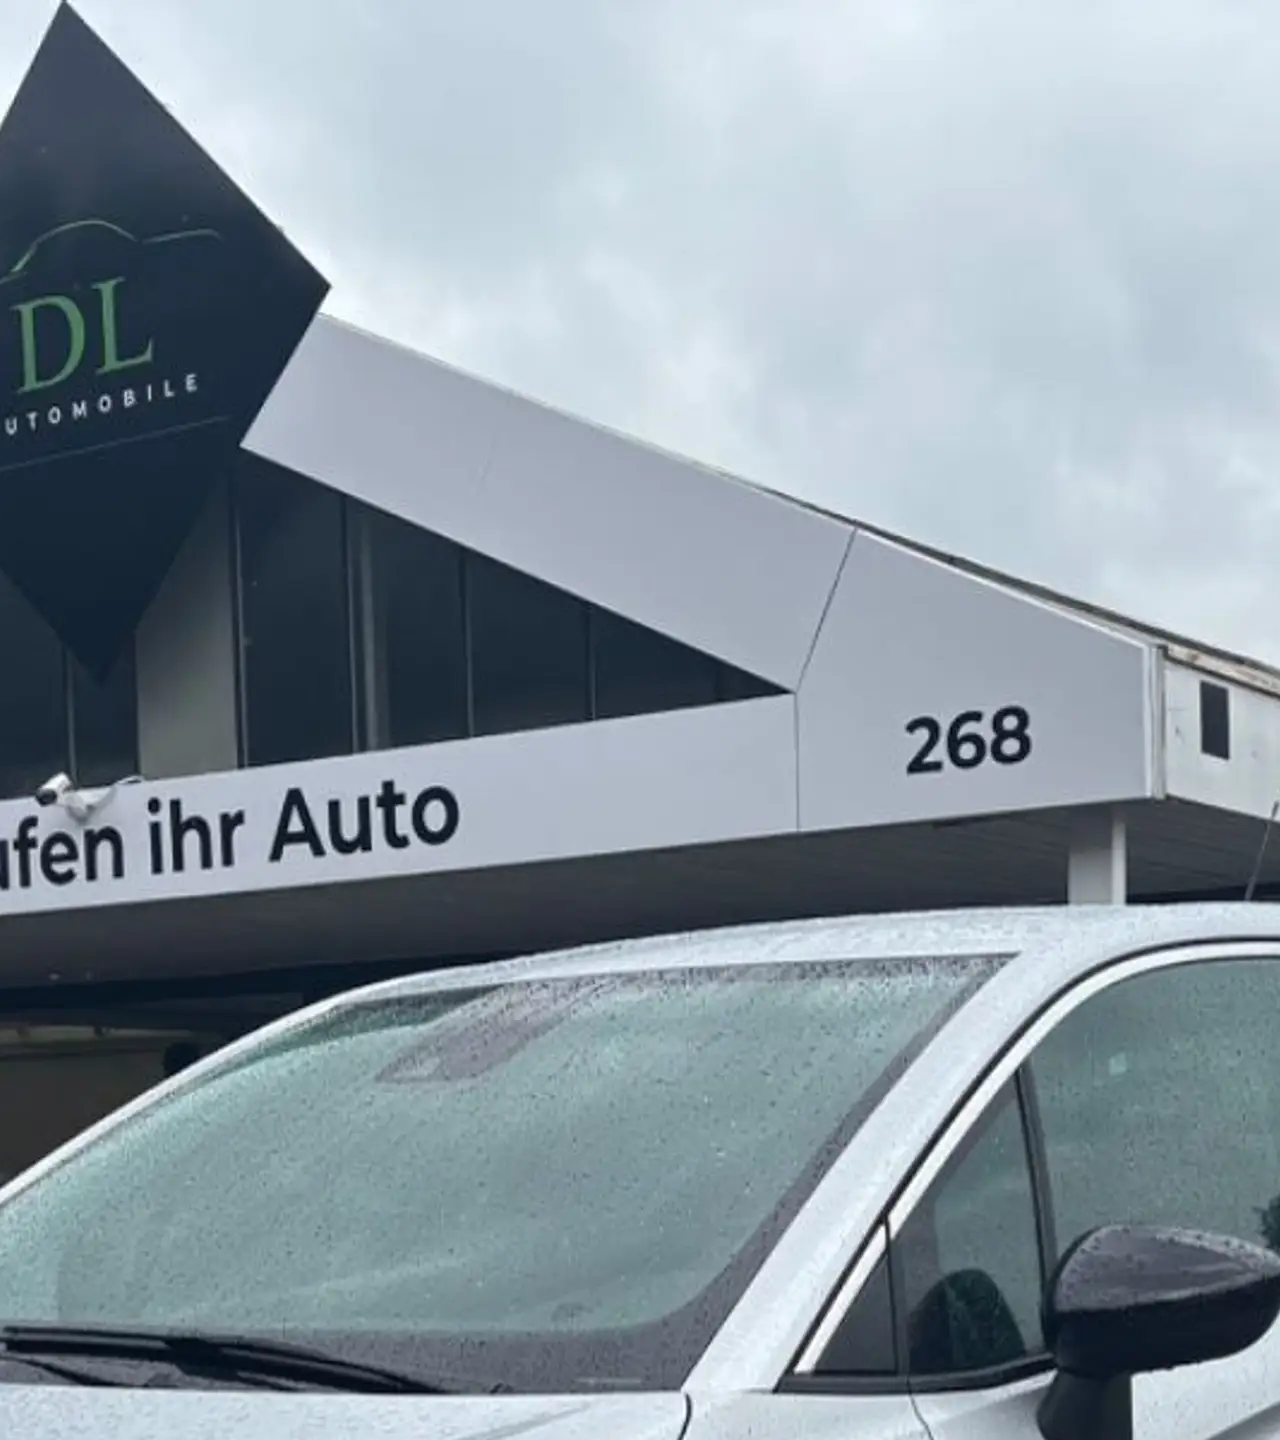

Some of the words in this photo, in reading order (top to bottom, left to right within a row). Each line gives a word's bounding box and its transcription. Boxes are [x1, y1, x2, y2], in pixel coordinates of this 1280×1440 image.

[10, 277, 153, 394] DL
[905, 705, 1032, 774] 268
[148, 797, 244, 875] ihr
[268, 779, 460, 863] Auto
